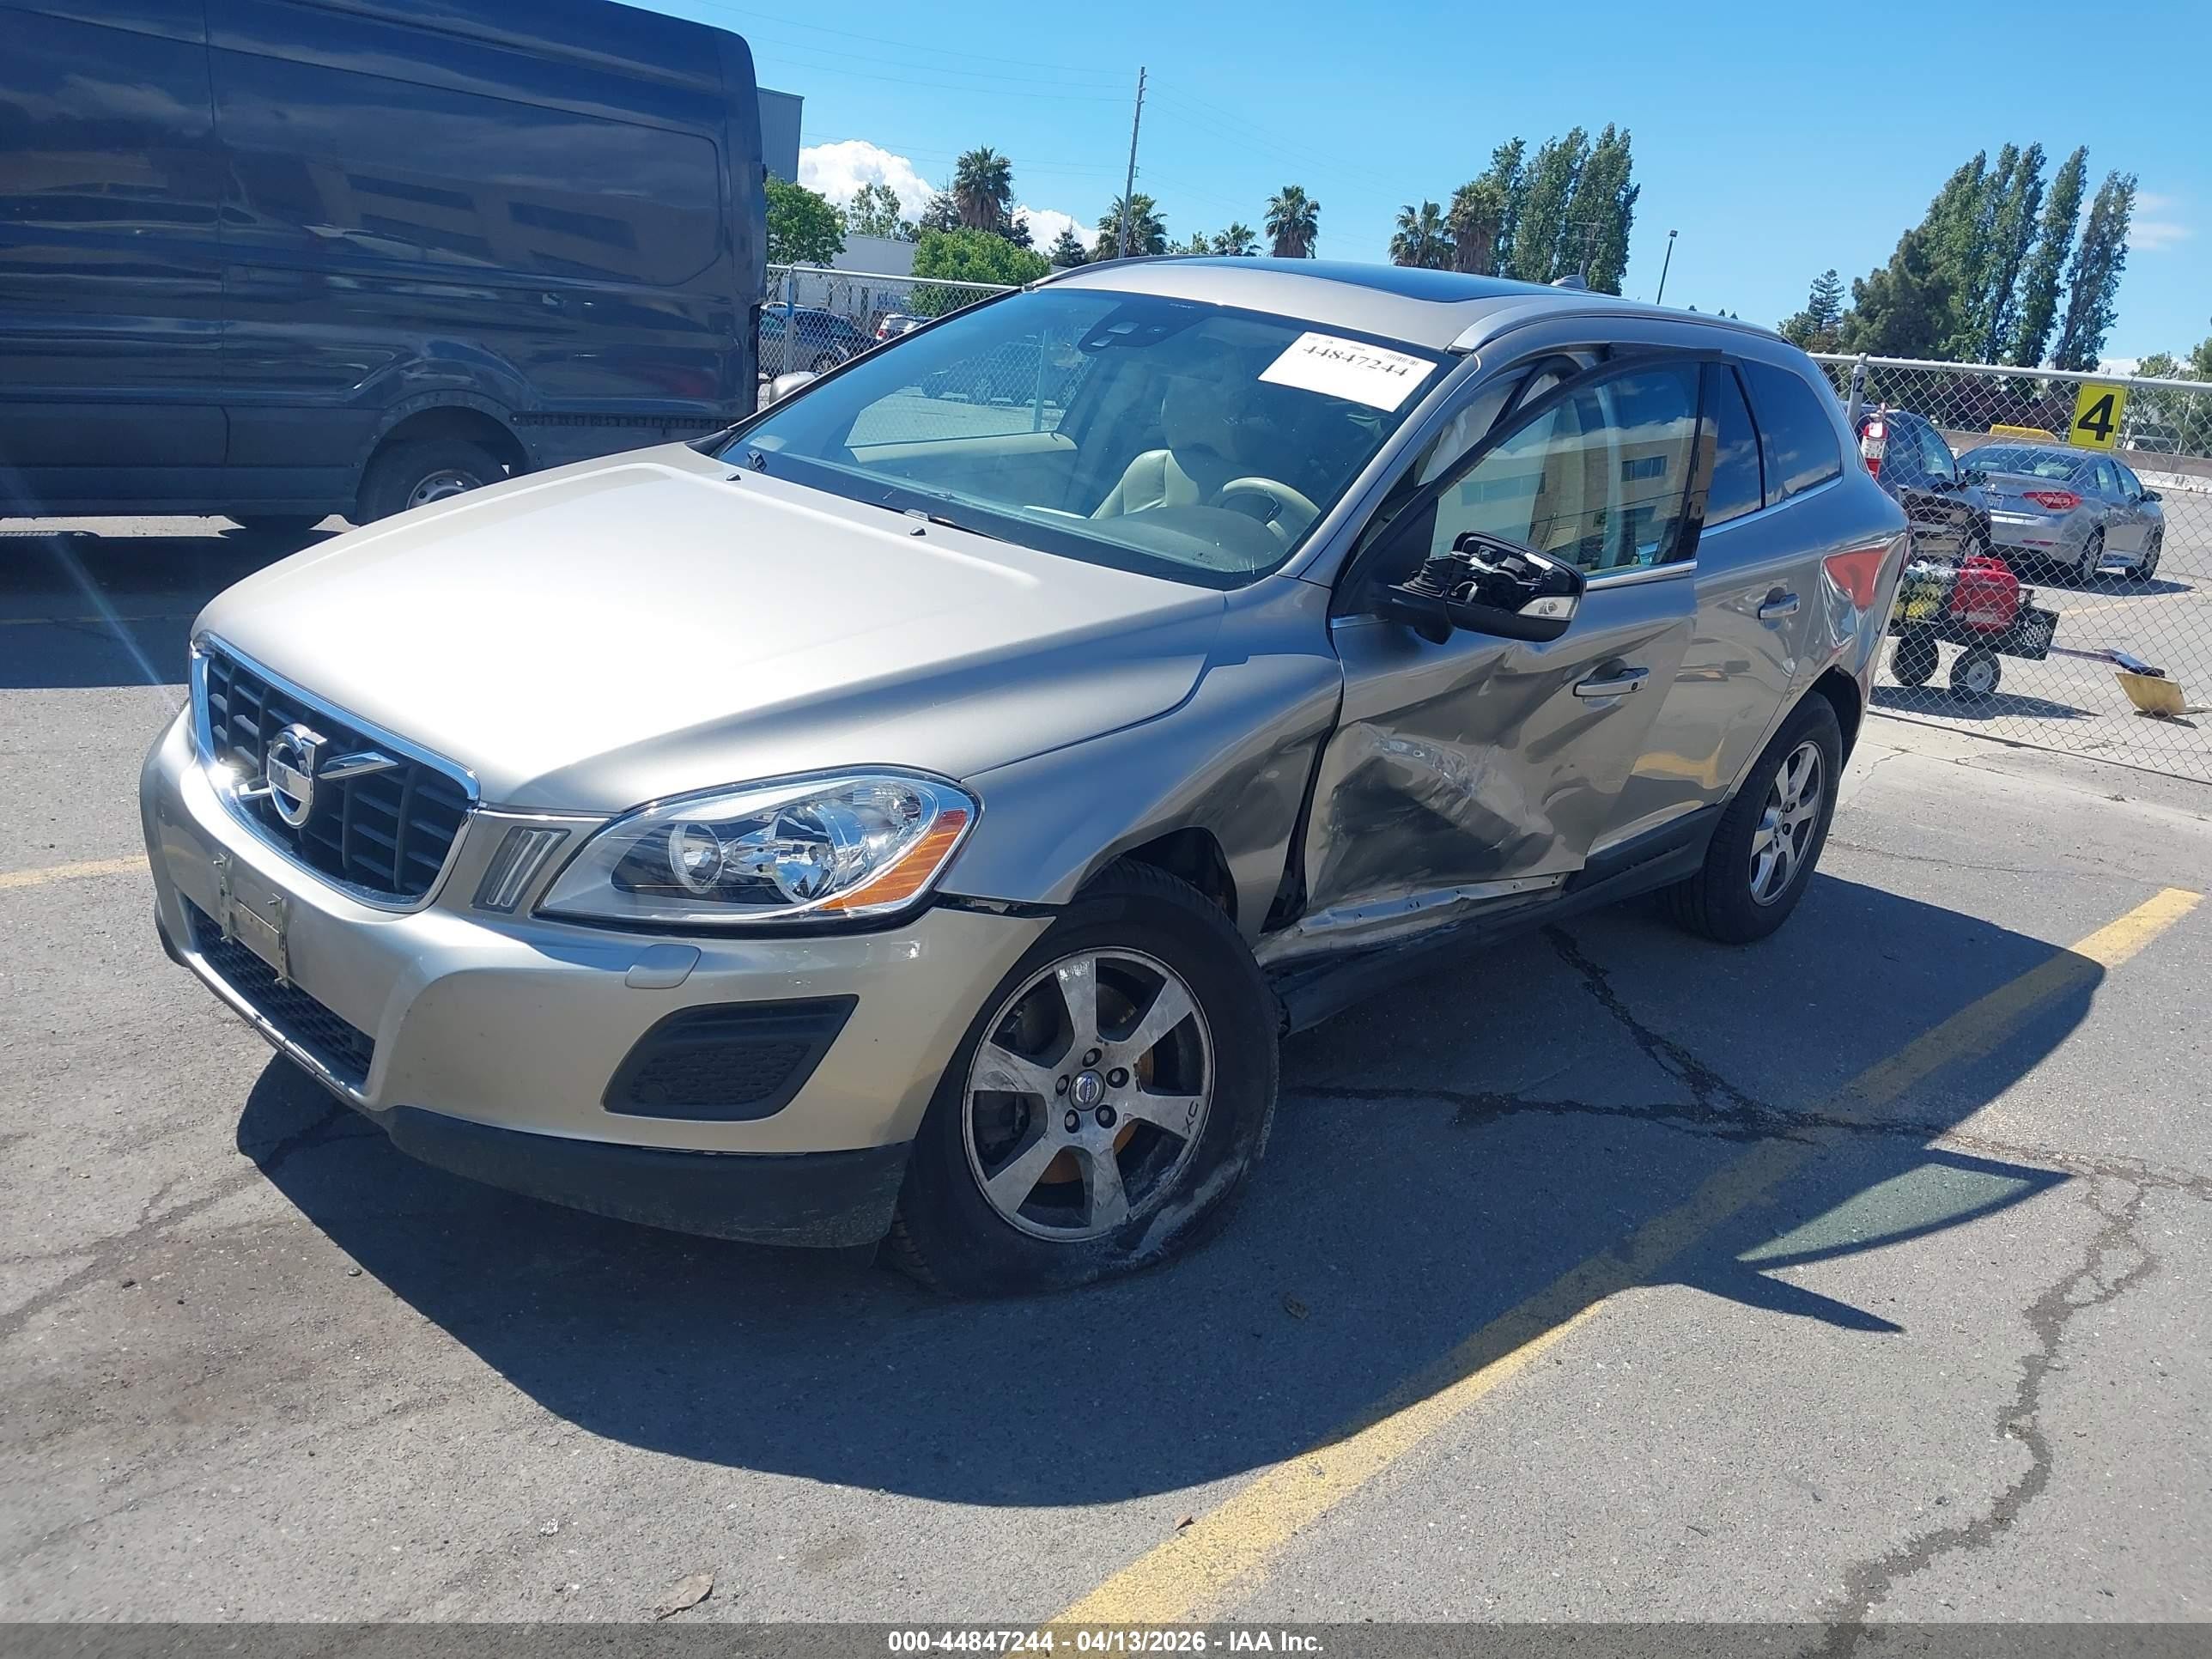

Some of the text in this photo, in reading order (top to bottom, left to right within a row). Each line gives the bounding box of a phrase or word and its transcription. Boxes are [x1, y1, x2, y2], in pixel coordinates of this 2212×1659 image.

[1303, 345, 1409, 376] 44847244
[2076, 393, 2115, 441] 4
[1182, 1099, 1199, 1135] XC
